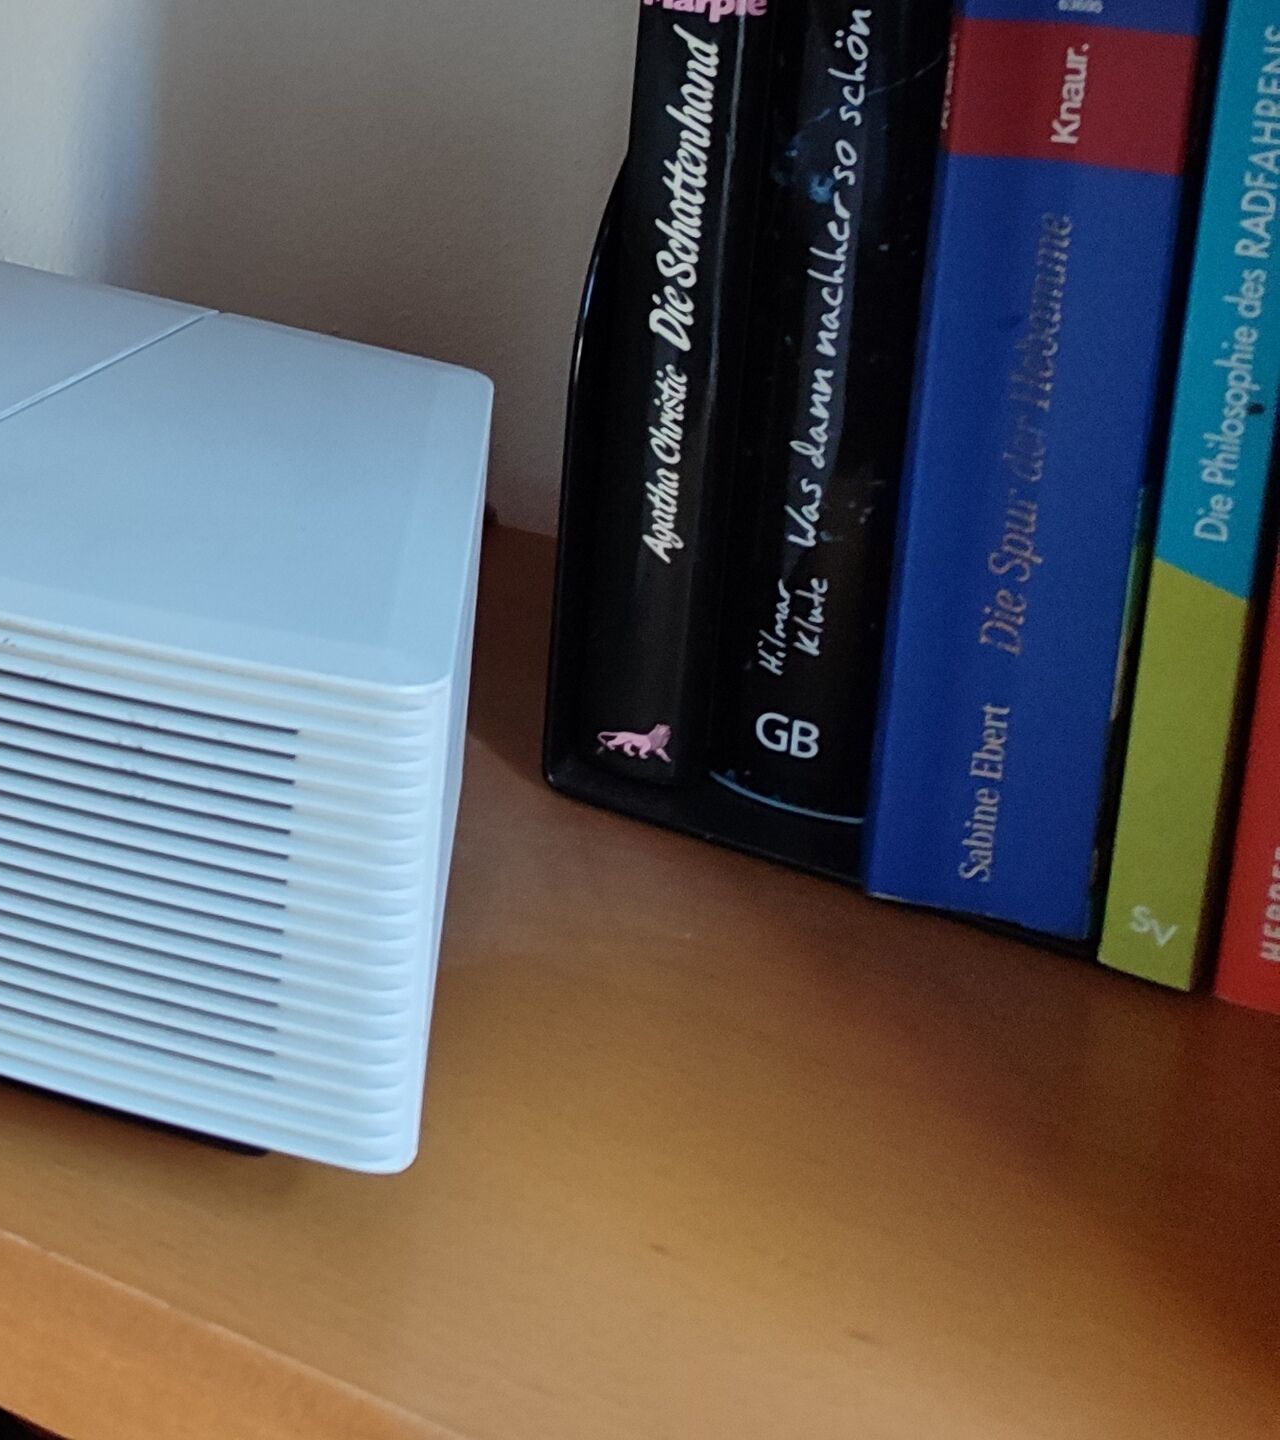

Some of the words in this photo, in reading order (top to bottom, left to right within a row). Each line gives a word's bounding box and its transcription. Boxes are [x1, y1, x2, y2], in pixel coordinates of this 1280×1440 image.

[827, 8, 873, 128] schön
[1050, 41, 1091, 146] Knaur.
[655, 23, 720, 290] Schattenhand
[834, 139, 858, 187] so
[649, 281, 695, 353] Die
[808, 192, 852, 356] nachher
[1223, 266, 1269, 321] des
[649, 363, 689, 465] Christie
[790, 369, 834, 469] dann
[1002, 413, 1048, 484] der
[1201, 322, 1260, 489] Philosophie
[641, 465, 685, 564] Agatha
[785, 479, 823, 548] Was
[988, 487, 1044, 582] Spur
[1193, 493, 1235, 544] Die
[757, 578, 793, 676] Hilmar
[793, 577, 830, 657] Klute
[980, 586, 1029, 657] Die
[755, 711, 821, 761] GB
[970, 703, 1010, 783] Ebert
[958, 780, 999, 883] Sabine
